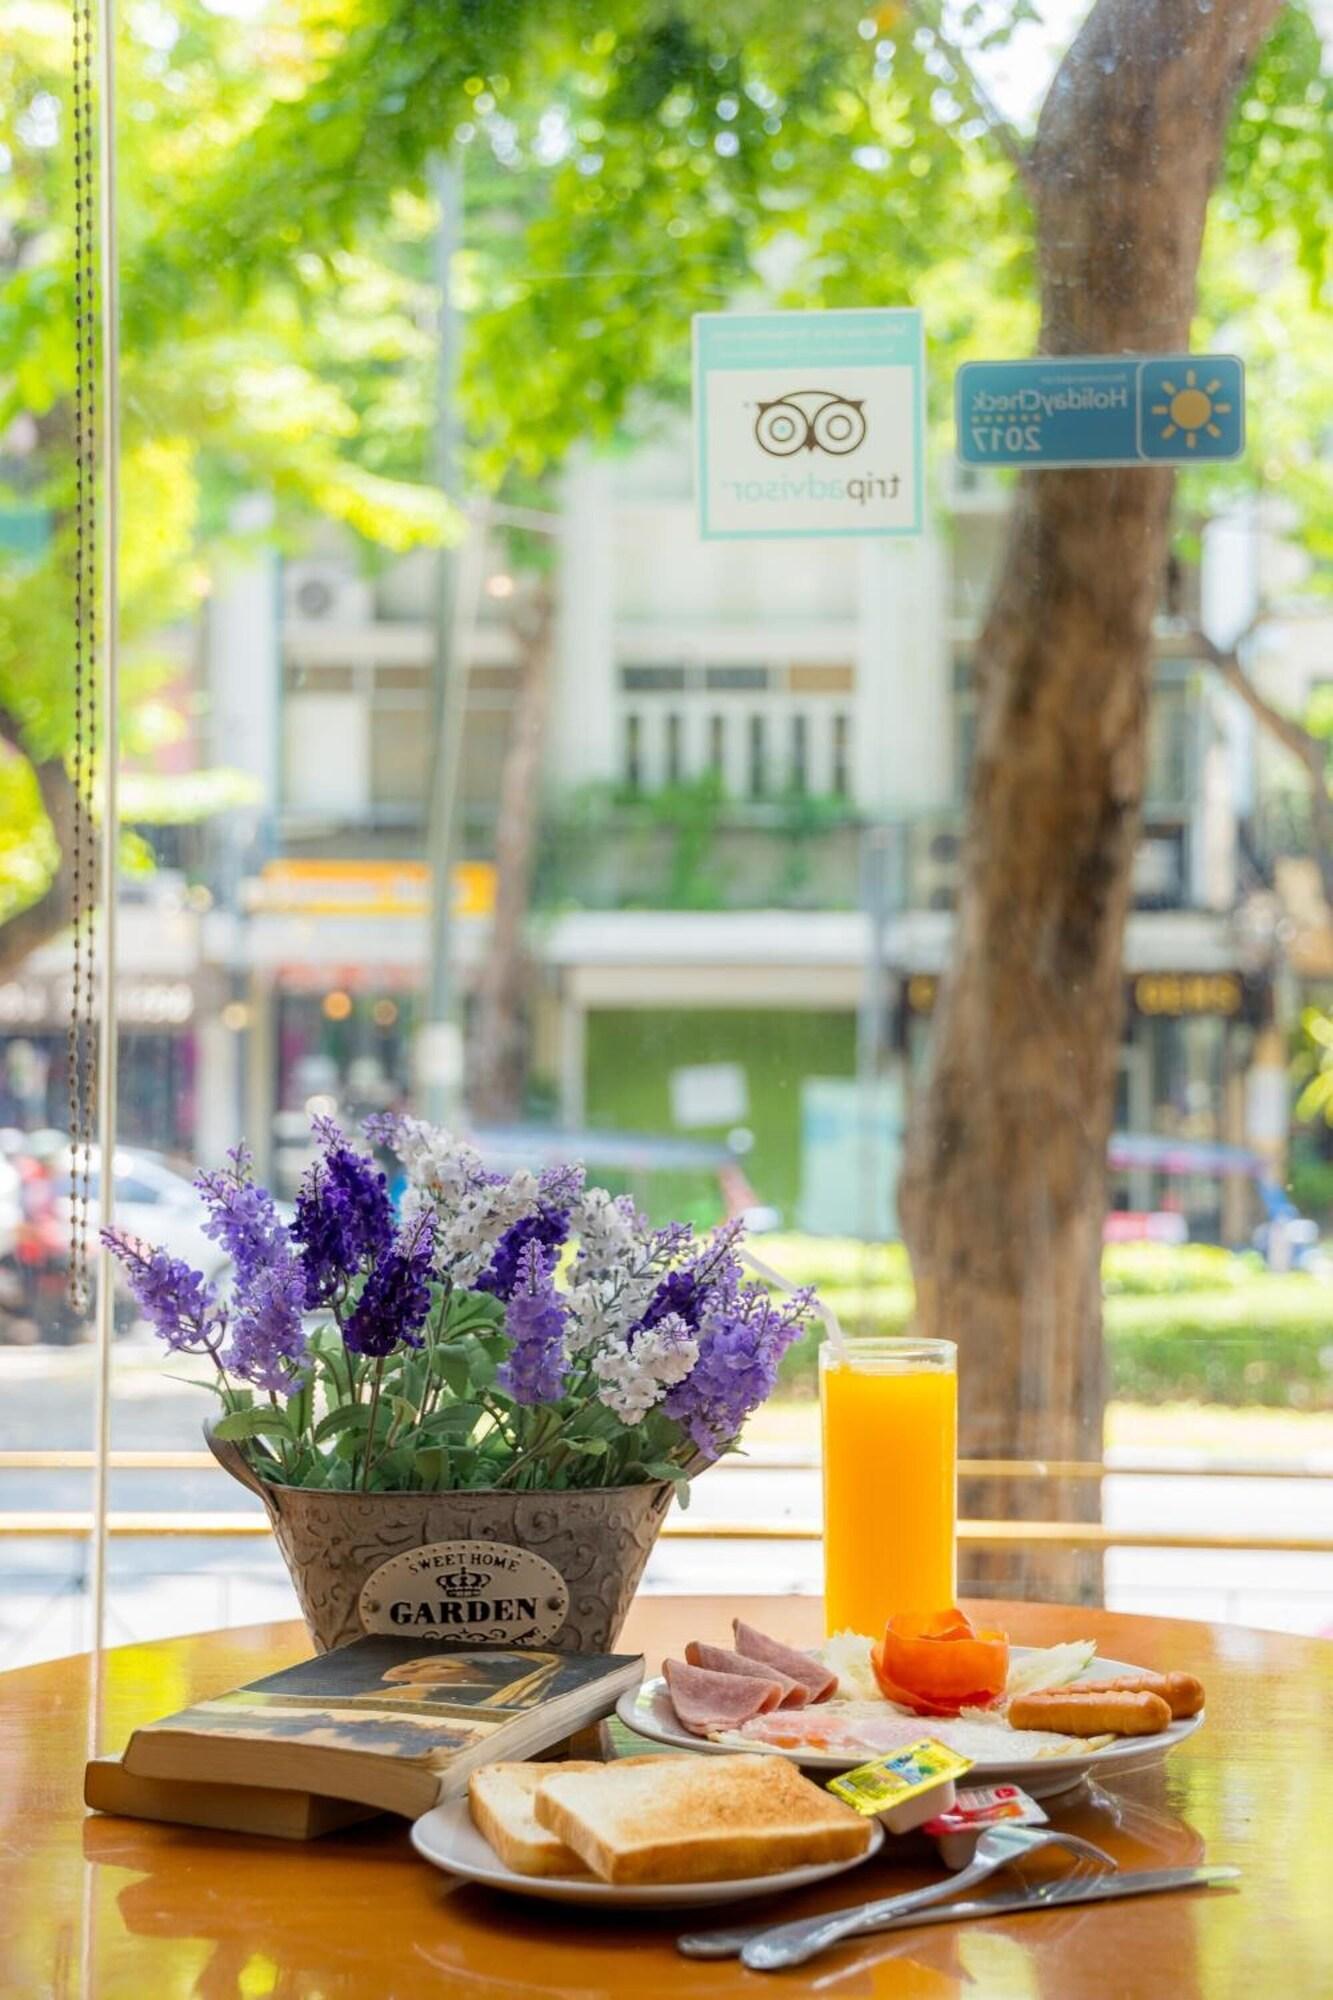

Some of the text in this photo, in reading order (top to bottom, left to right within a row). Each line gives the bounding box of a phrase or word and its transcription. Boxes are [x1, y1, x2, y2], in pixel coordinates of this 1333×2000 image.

[408, 1553, 521, 1574] SWEET HOME
[389, 1598, 537, 1626] GARDEN
